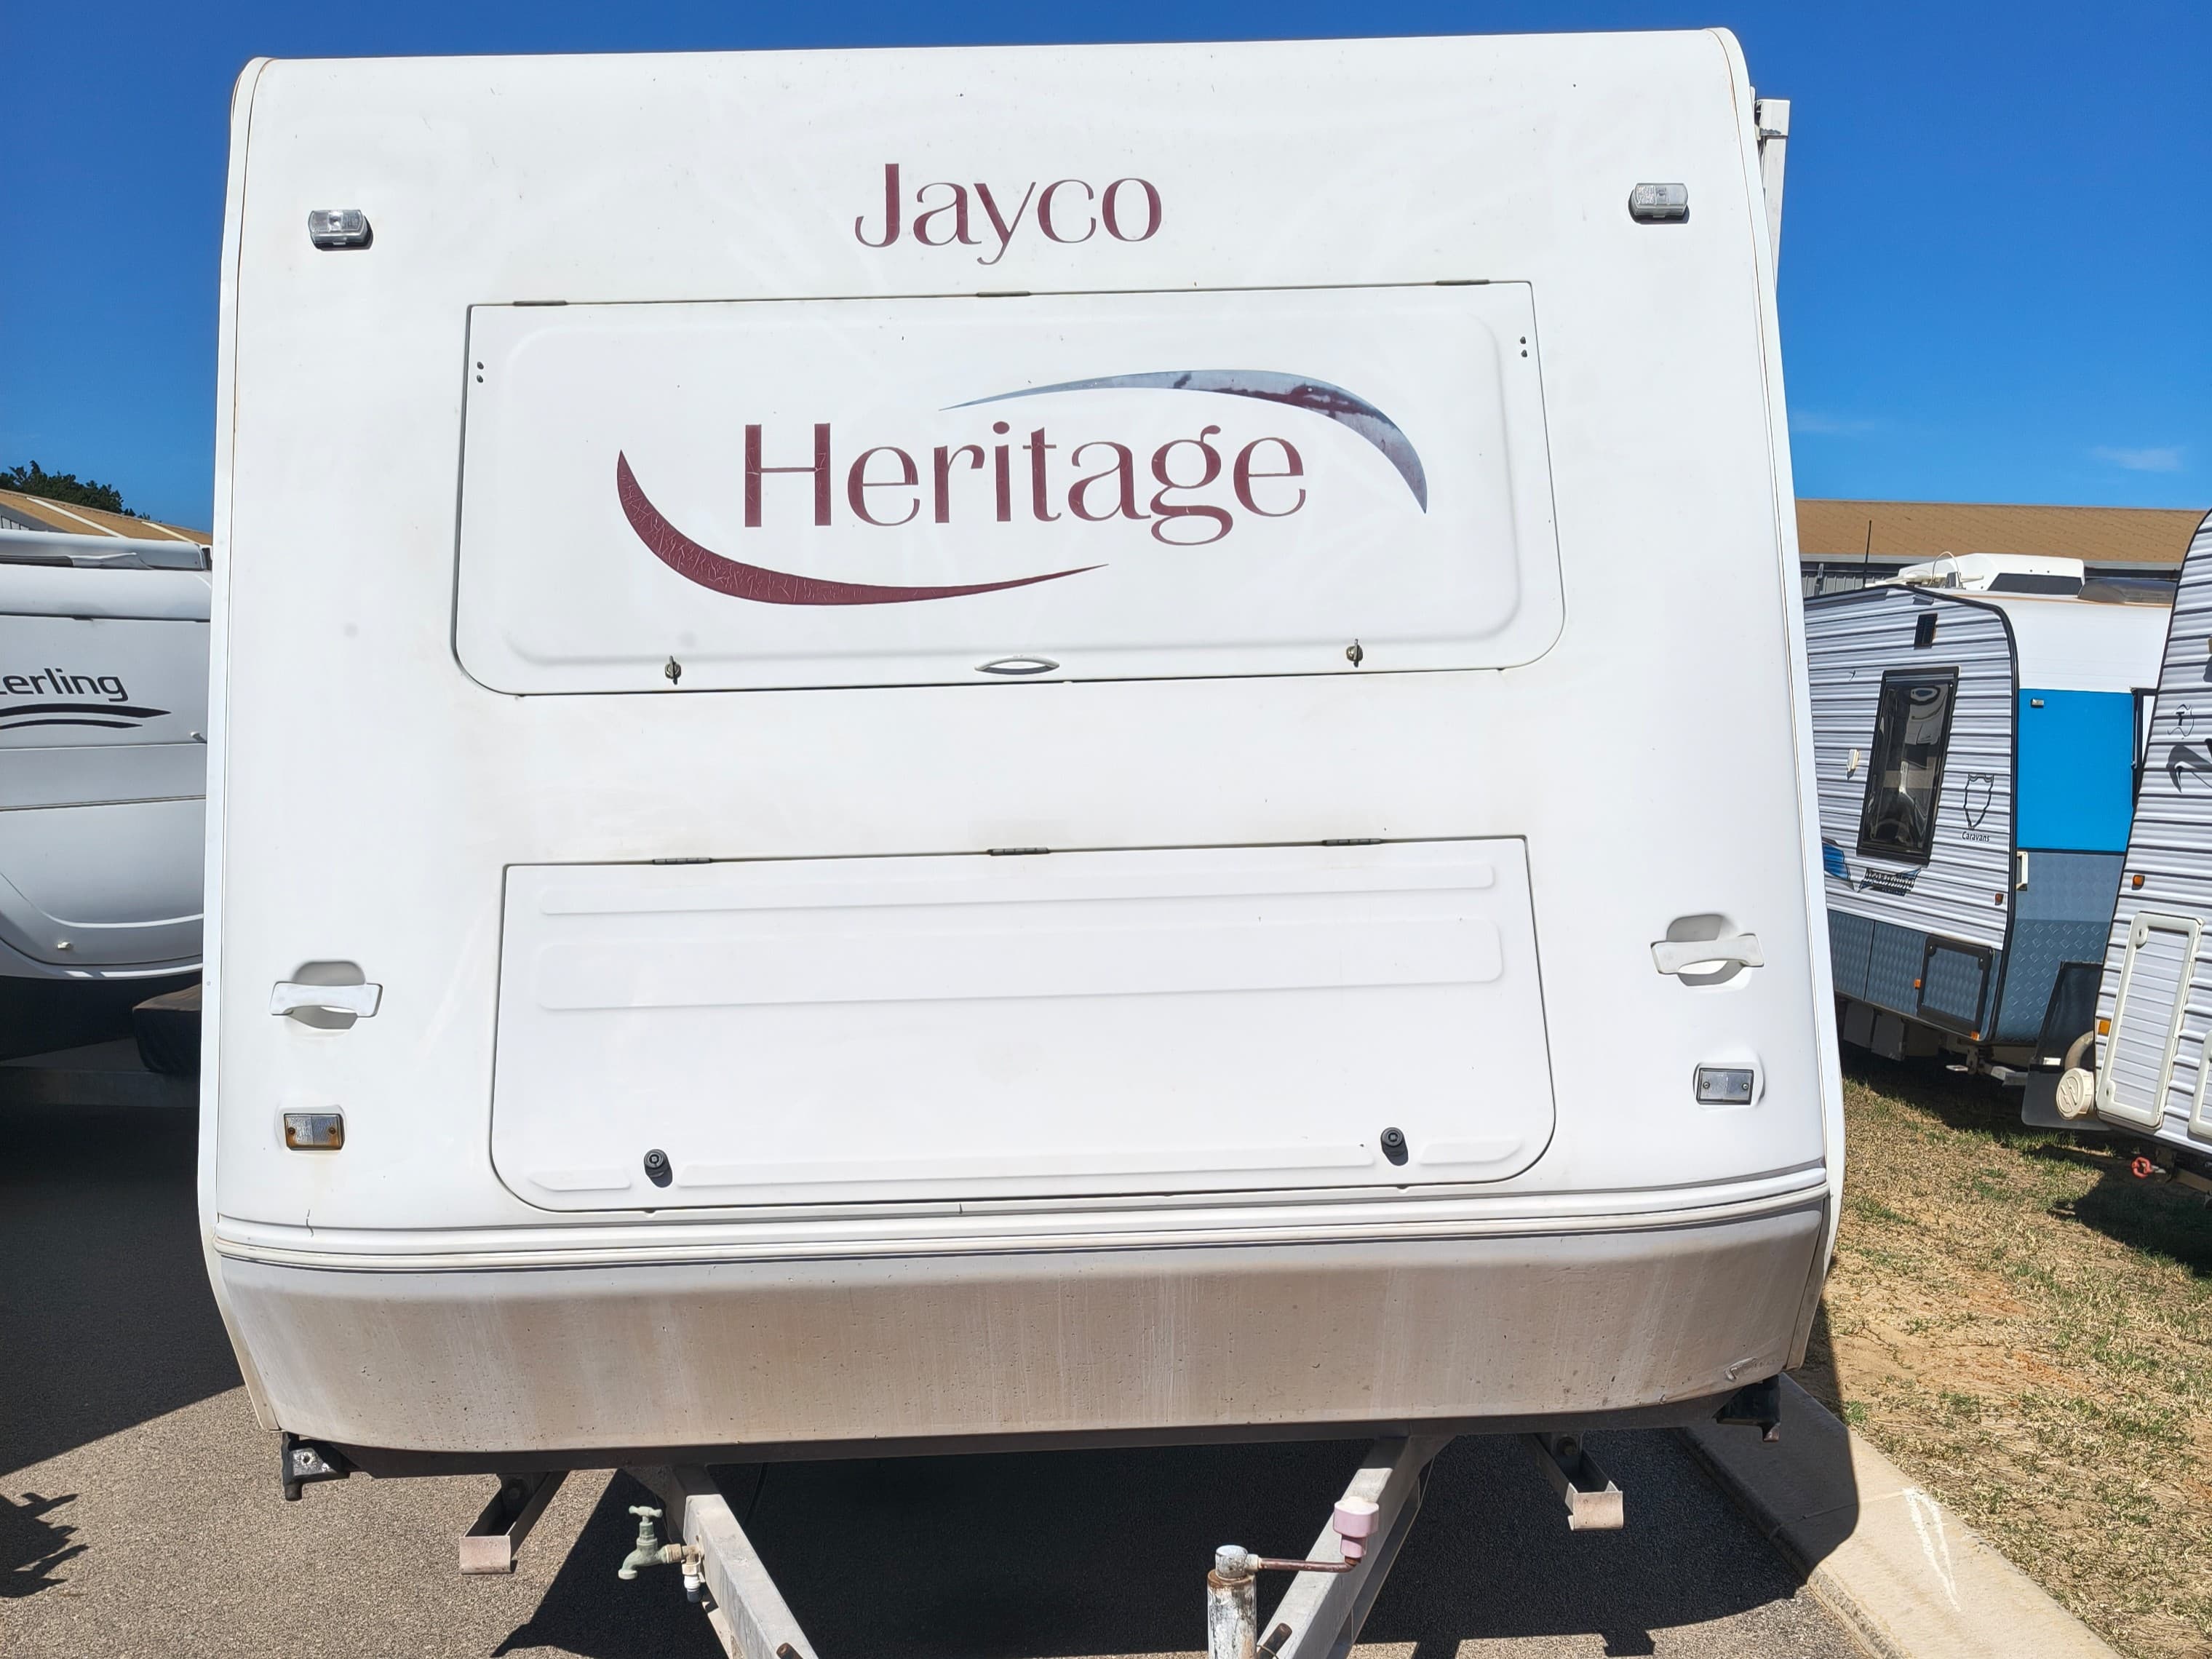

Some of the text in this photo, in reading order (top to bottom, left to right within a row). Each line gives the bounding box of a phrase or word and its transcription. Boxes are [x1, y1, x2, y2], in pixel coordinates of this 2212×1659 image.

[855, 163, 1162, 266] Jayco
[744, 421, 1307, 546] Heritage
[0, 667, 129, 702] erling
[1962, 831, 1990, 843] Caravans
